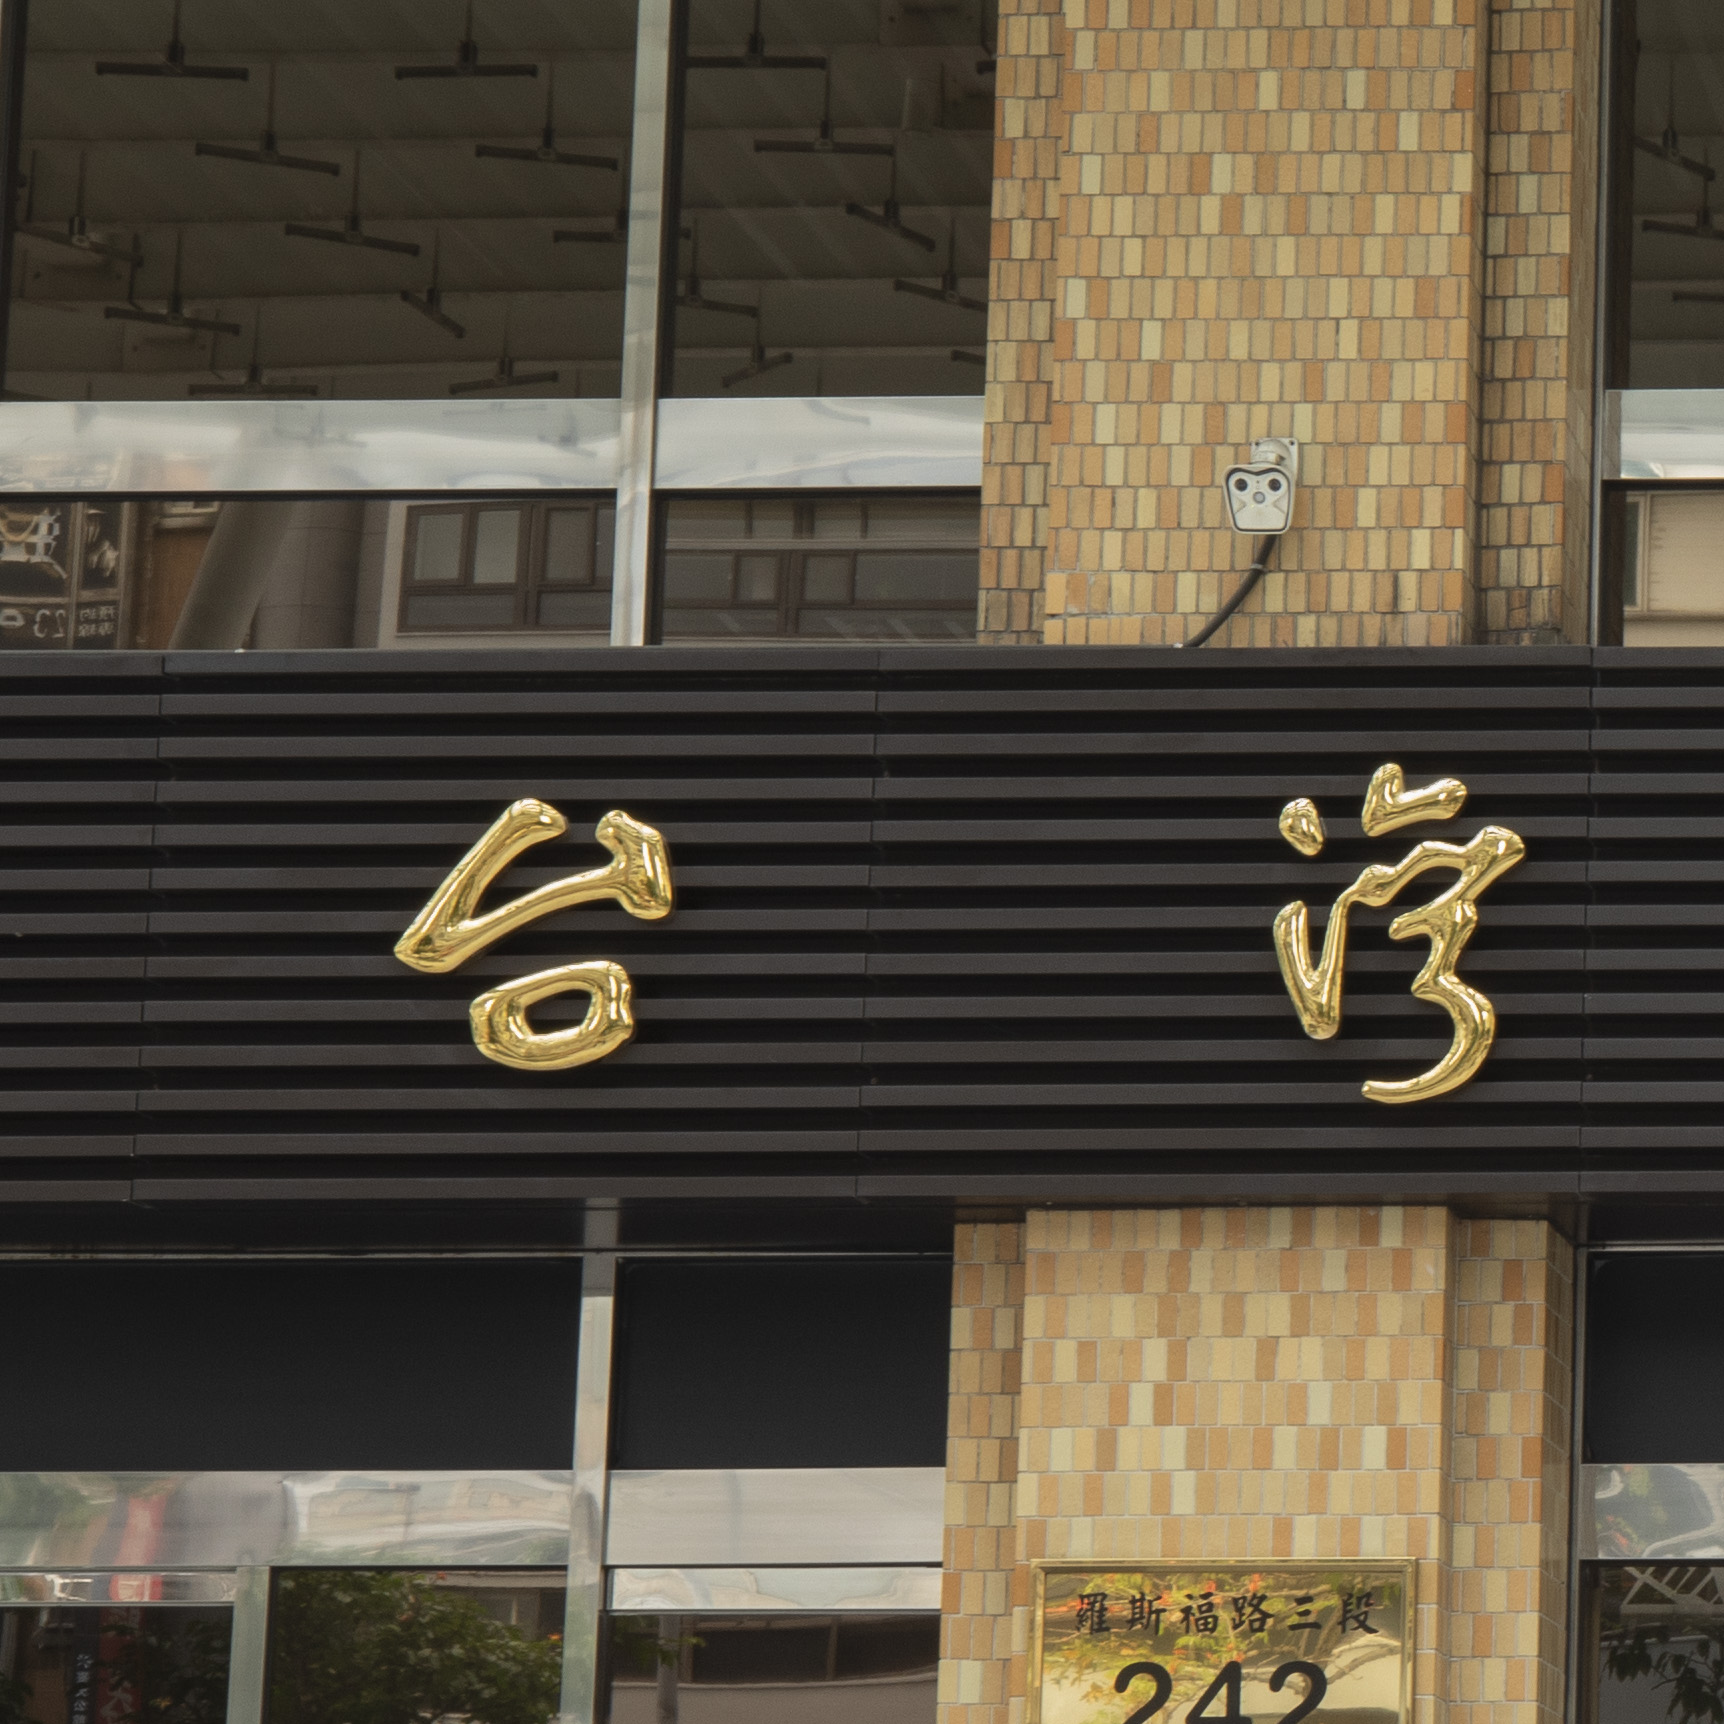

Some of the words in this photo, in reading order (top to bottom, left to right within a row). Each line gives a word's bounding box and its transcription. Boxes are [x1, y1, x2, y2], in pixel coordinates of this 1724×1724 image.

[1075, 1591, 1380, 1636] 羅斯福路三段
